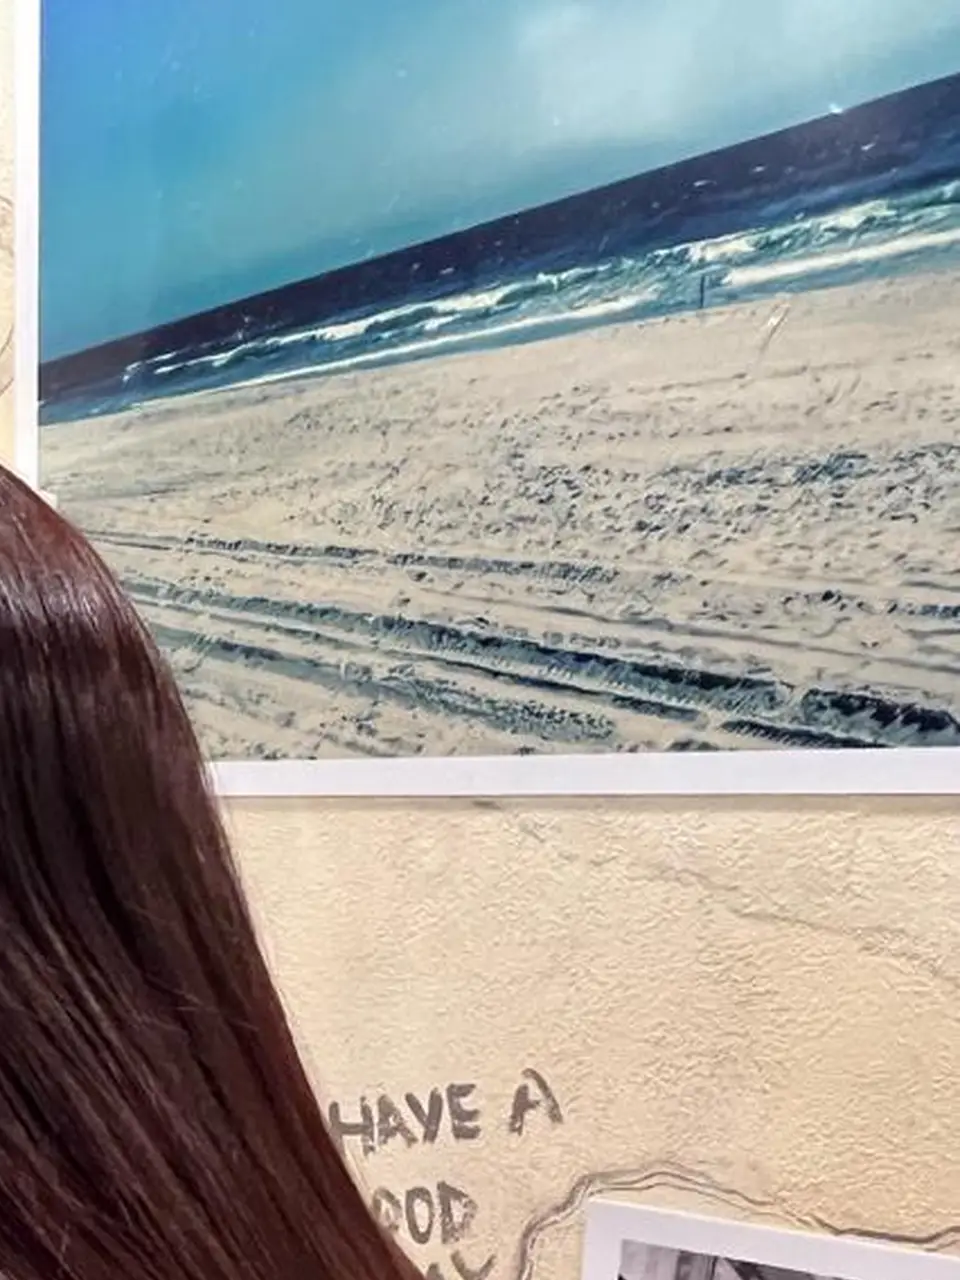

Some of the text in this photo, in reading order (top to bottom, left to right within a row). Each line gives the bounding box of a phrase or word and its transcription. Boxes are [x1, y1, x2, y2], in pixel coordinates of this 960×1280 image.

[328, 1067, 564, 1156] HAVE A
[371, 1181, 479, 1245] OOD
